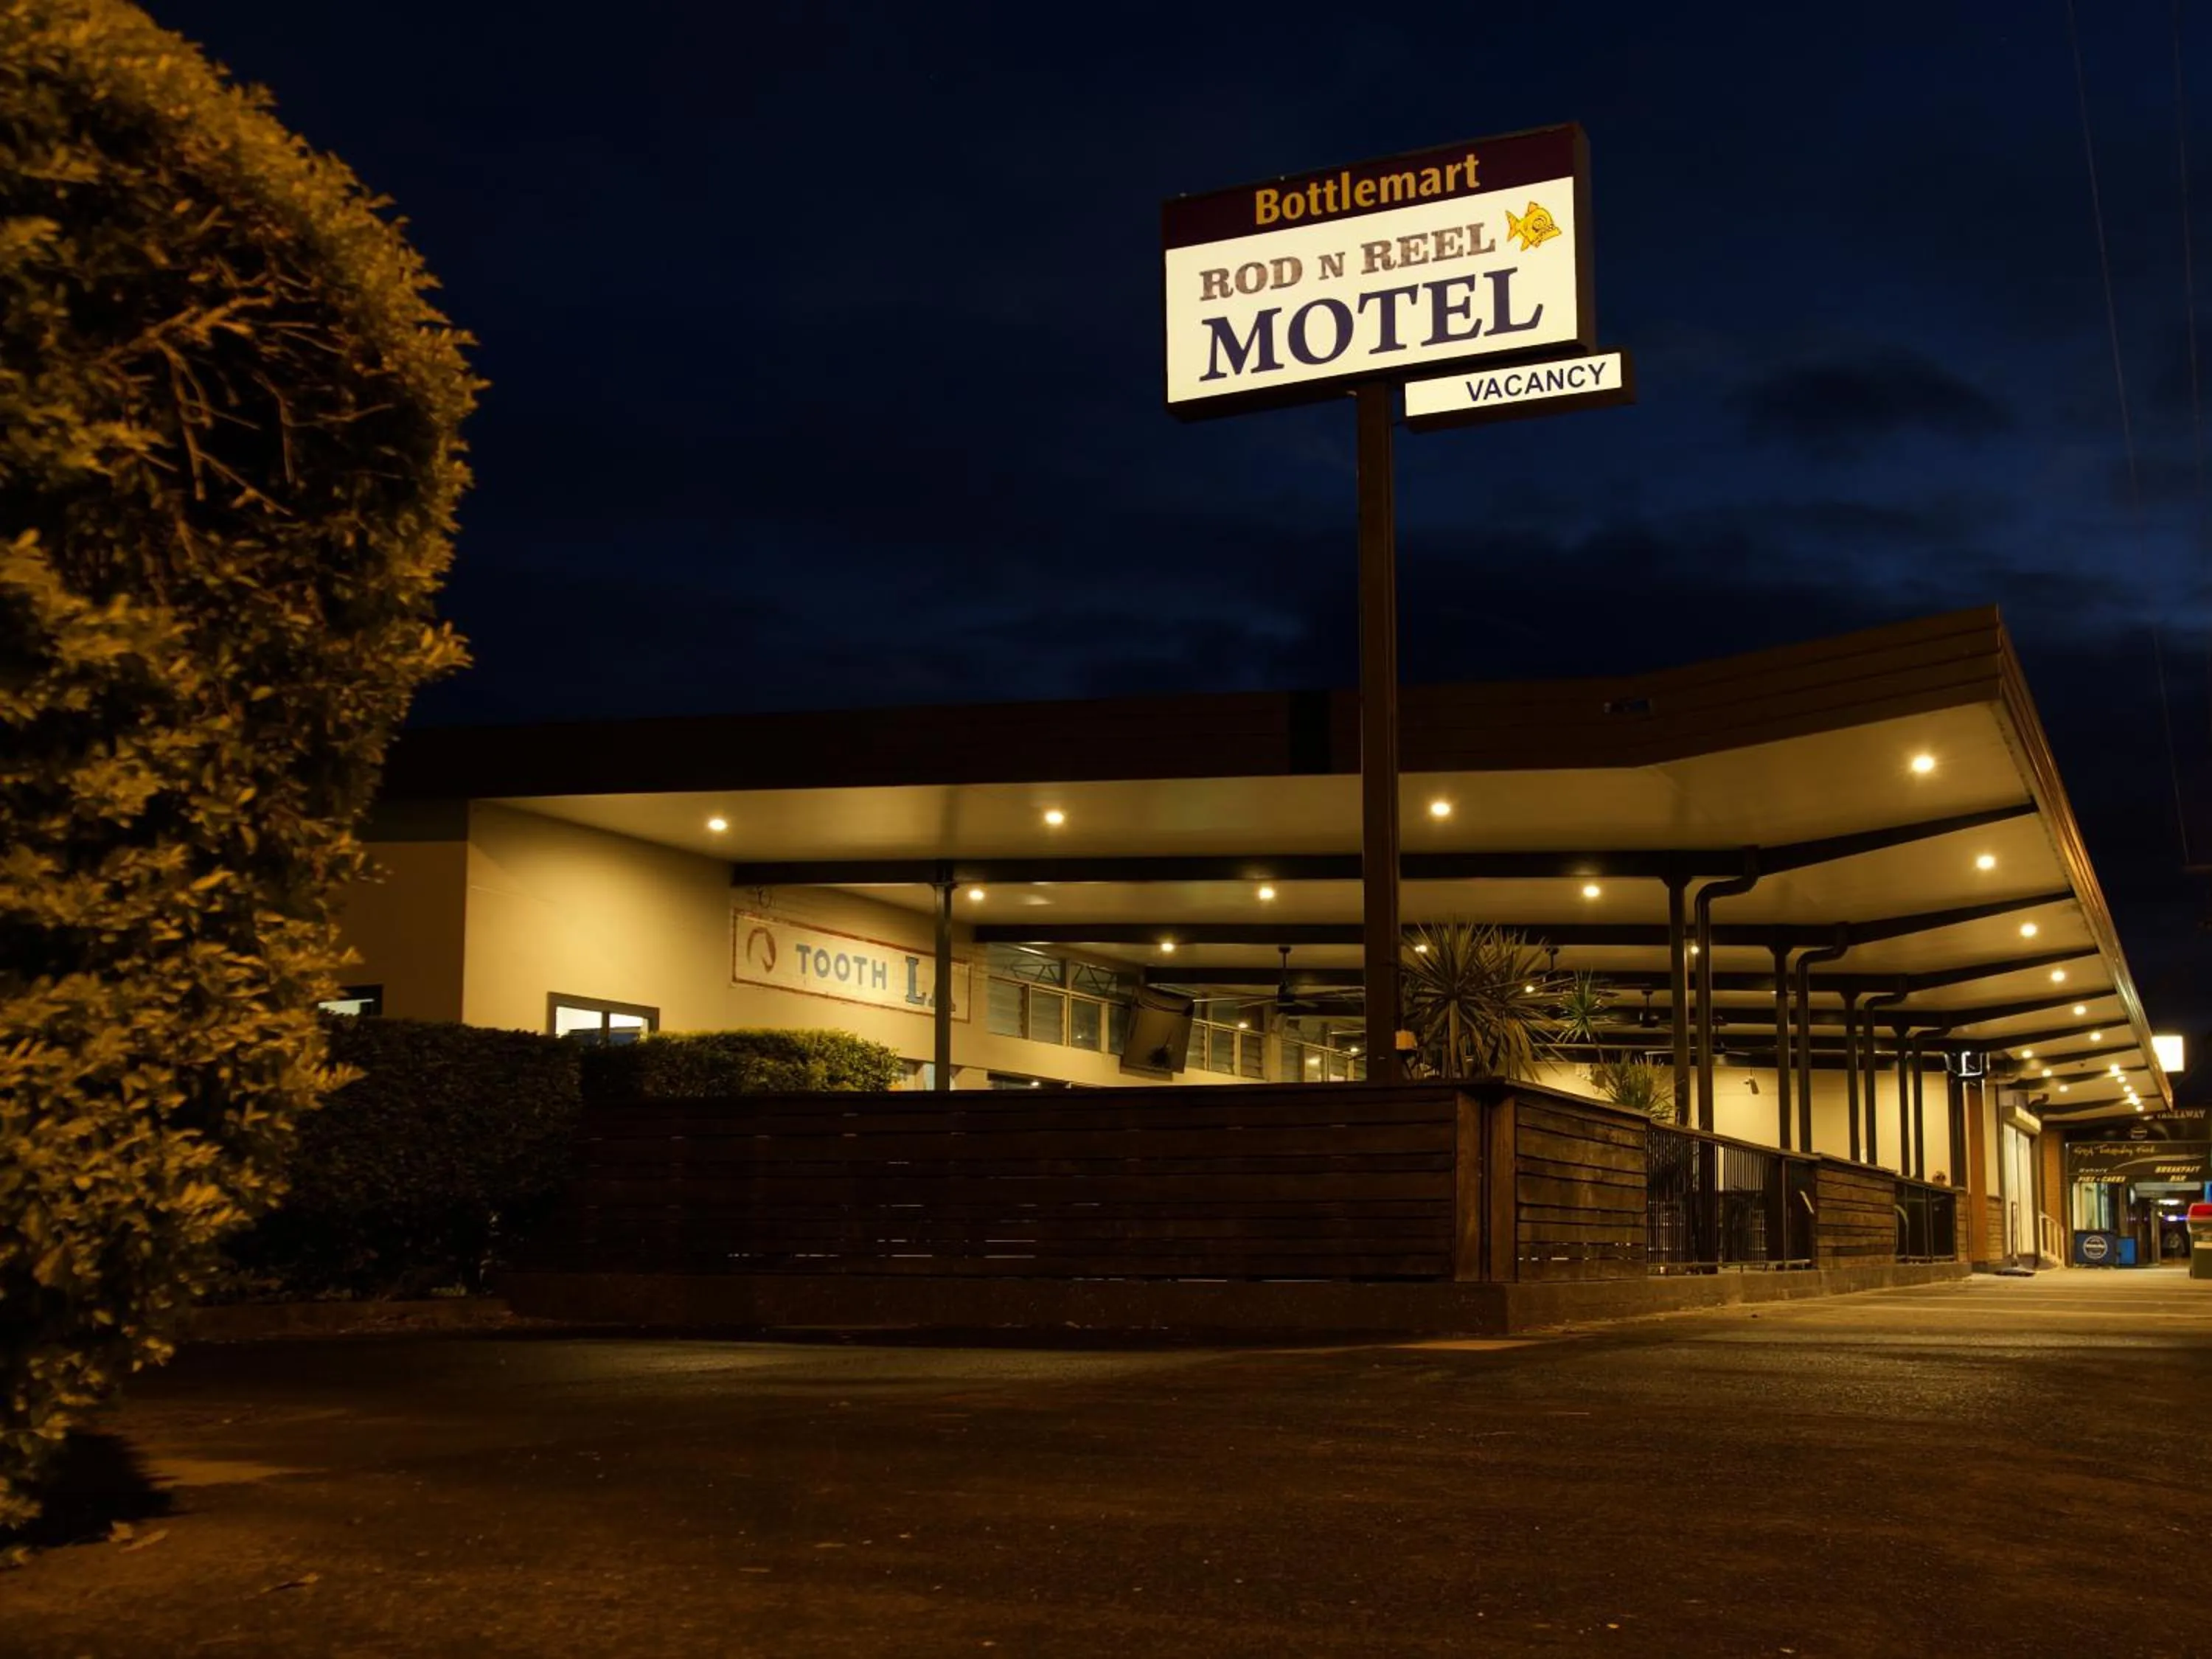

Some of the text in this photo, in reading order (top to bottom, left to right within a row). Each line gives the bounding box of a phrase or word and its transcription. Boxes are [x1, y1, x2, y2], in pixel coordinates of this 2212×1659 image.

[1254, 153, 1481, 226] Bottlemart
[1200, 223, 1496, 302] ROD N REEL
[1199, 267, 1544, 382] MOTEL
[1466, 362, 1606, 402] VACANCY
[796, 943, 887, 990] TOOTH
